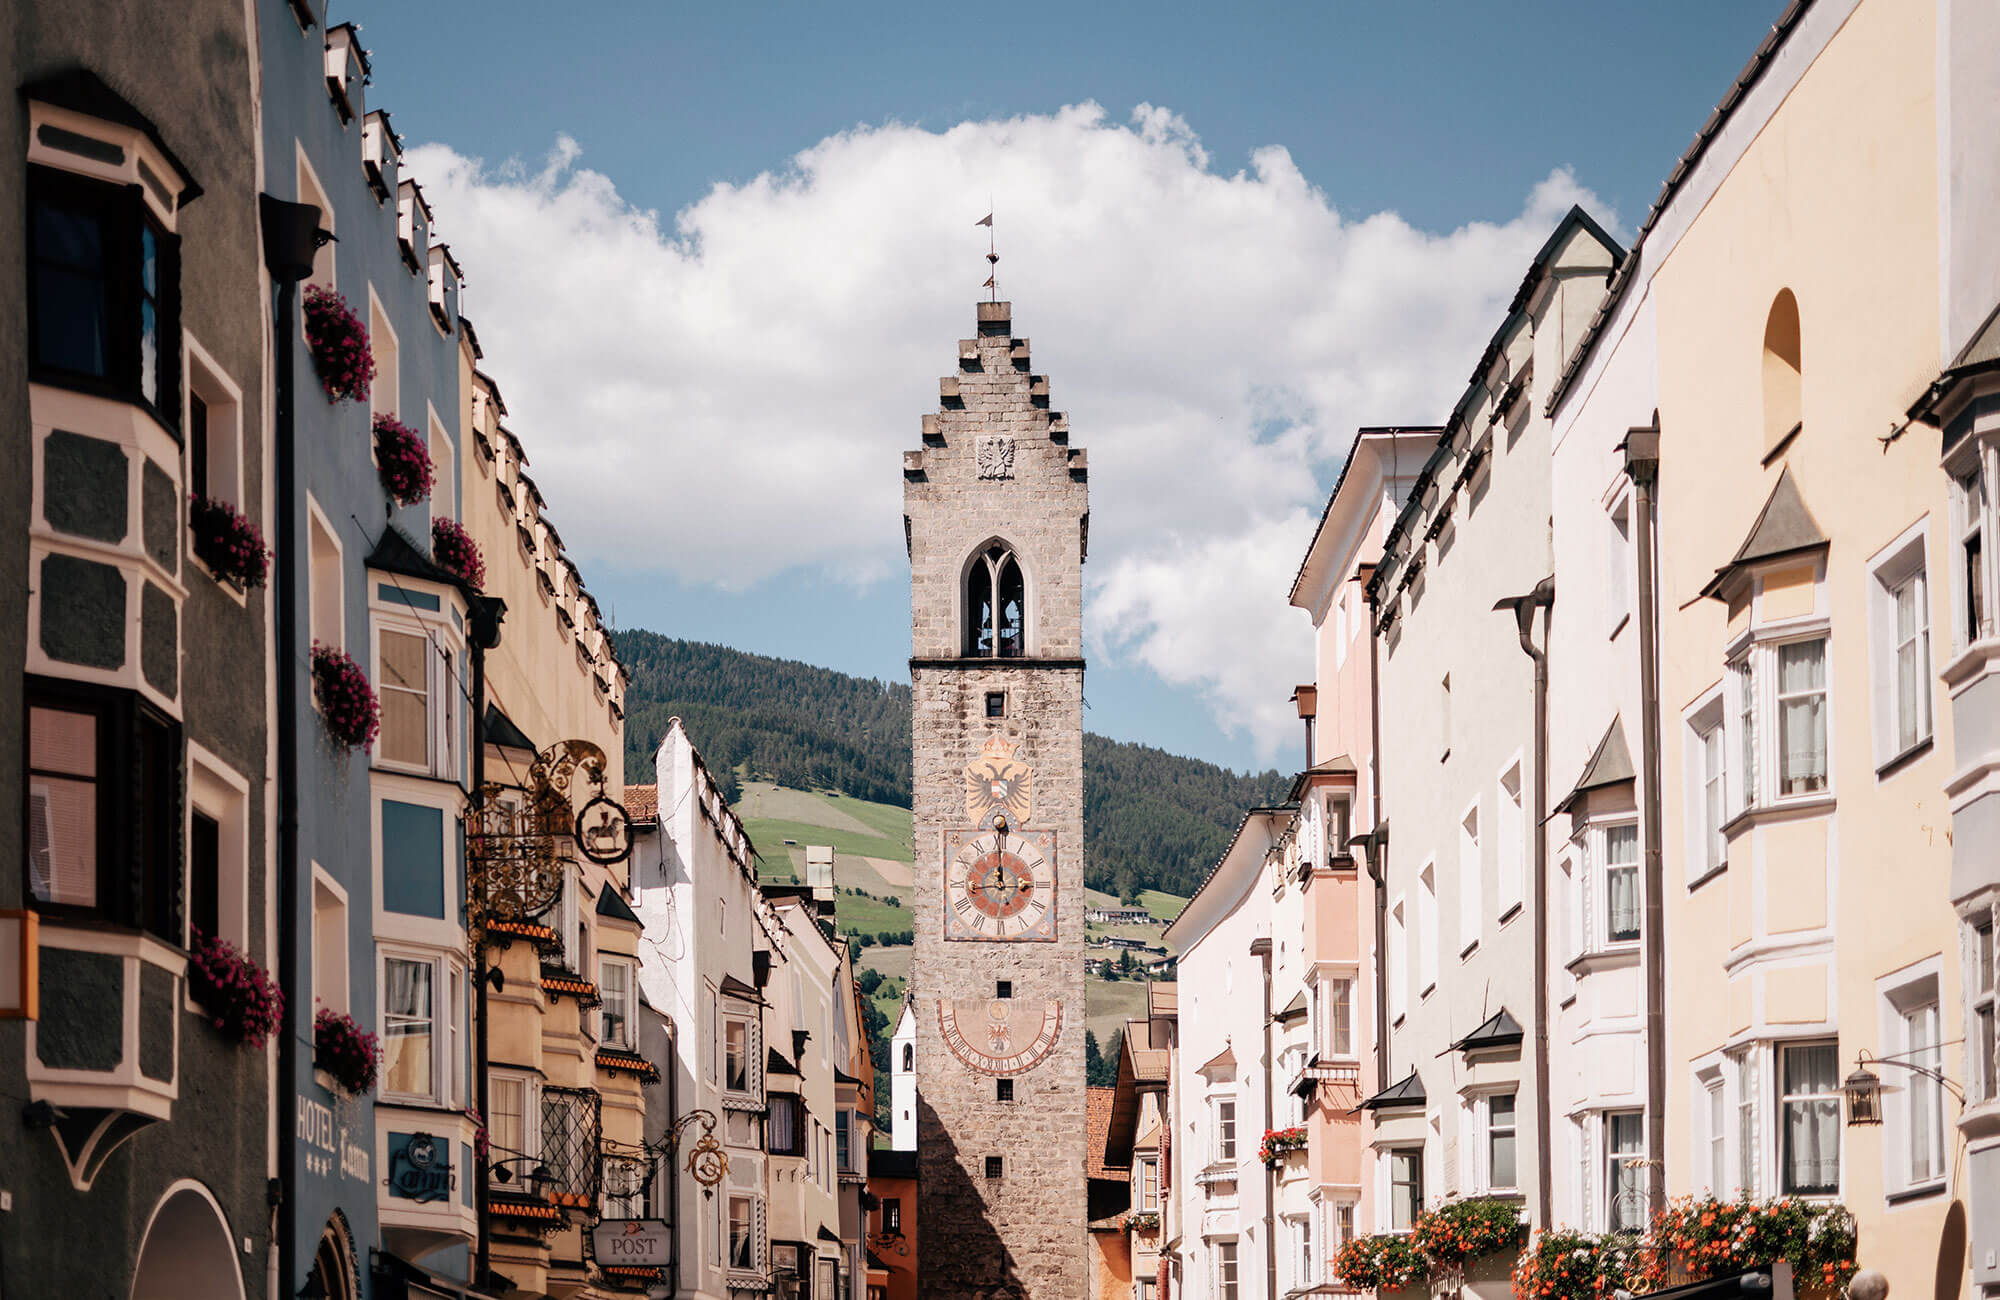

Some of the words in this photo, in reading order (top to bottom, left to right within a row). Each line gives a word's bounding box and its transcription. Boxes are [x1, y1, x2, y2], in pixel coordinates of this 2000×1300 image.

[970, 840, 985, 856] XI
[1017, 841, 1025, 854] I
[956, 856, 971, 870] X
[1030, 858, 1044, 869] II
[954, 897, 972, 915] VIII
[1018, 915, 1029, 930] V
[296, 1094, 336, 1153] HOTEL
[611, 1238, 657, 1255] POST
